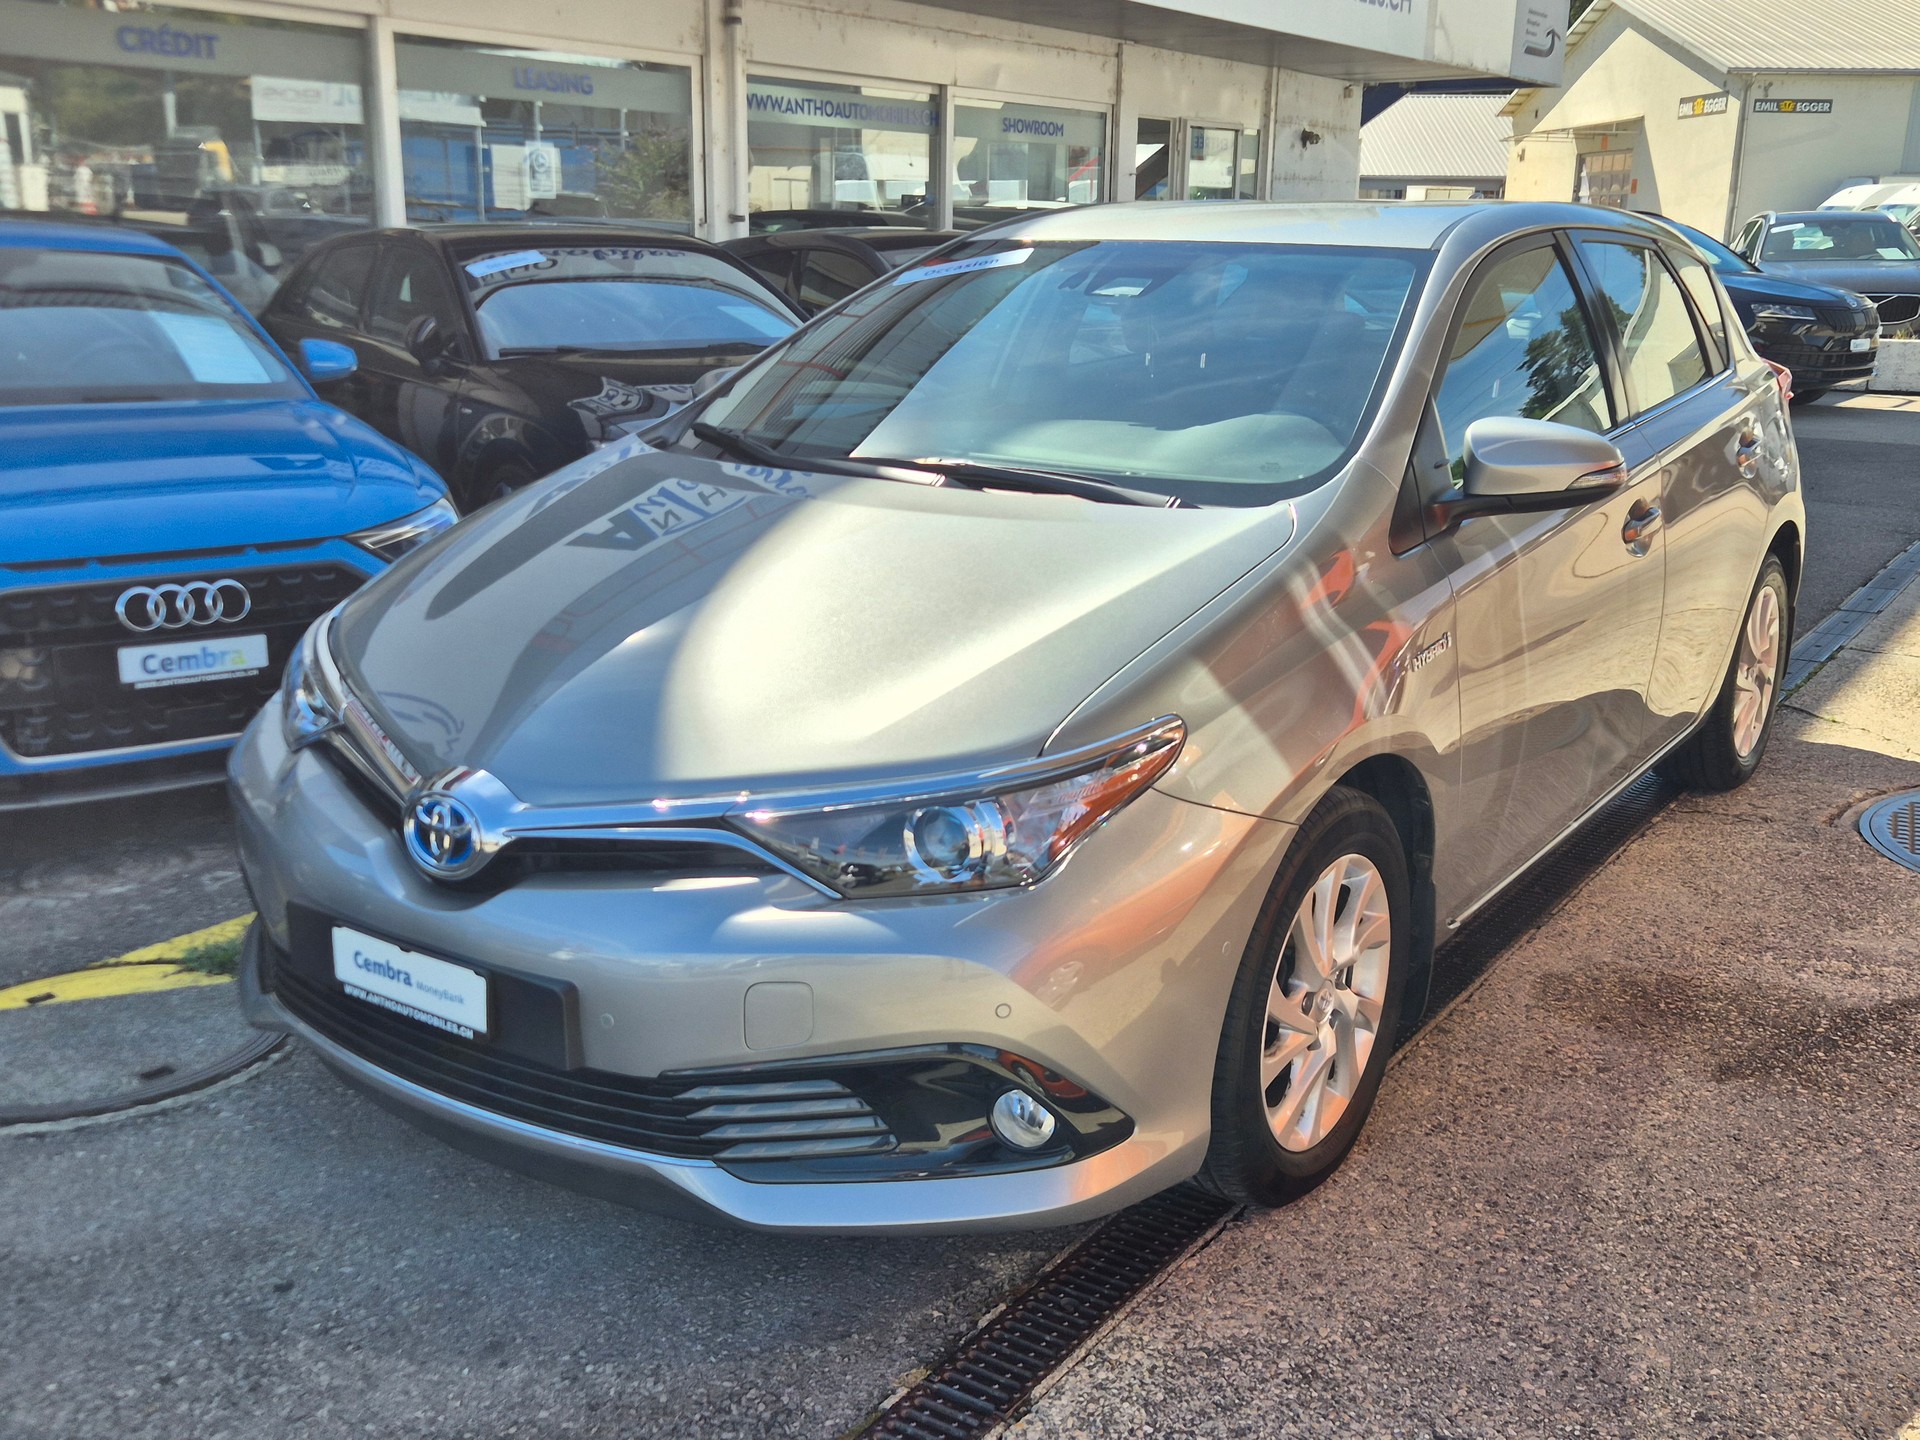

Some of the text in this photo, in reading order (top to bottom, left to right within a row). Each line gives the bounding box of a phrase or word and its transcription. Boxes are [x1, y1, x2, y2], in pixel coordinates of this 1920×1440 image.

[116, 24, 219, 59] CRÉDIT
[514, 67, 594, 96] LEASING
[1679, 97, 1727, 117] EMIL EGGER
[1755, 101, 1831, 112] EMIL EGGER
[1002, 117, 1064, 137] SHOWROOM
[924, 259, 999, 277] Occasion
[142, 647, 247, 674] Cembra
[1411, 638, 1448, 671] HYBRID
[353, 950, 465, 1005] Cembra MoneyBank
